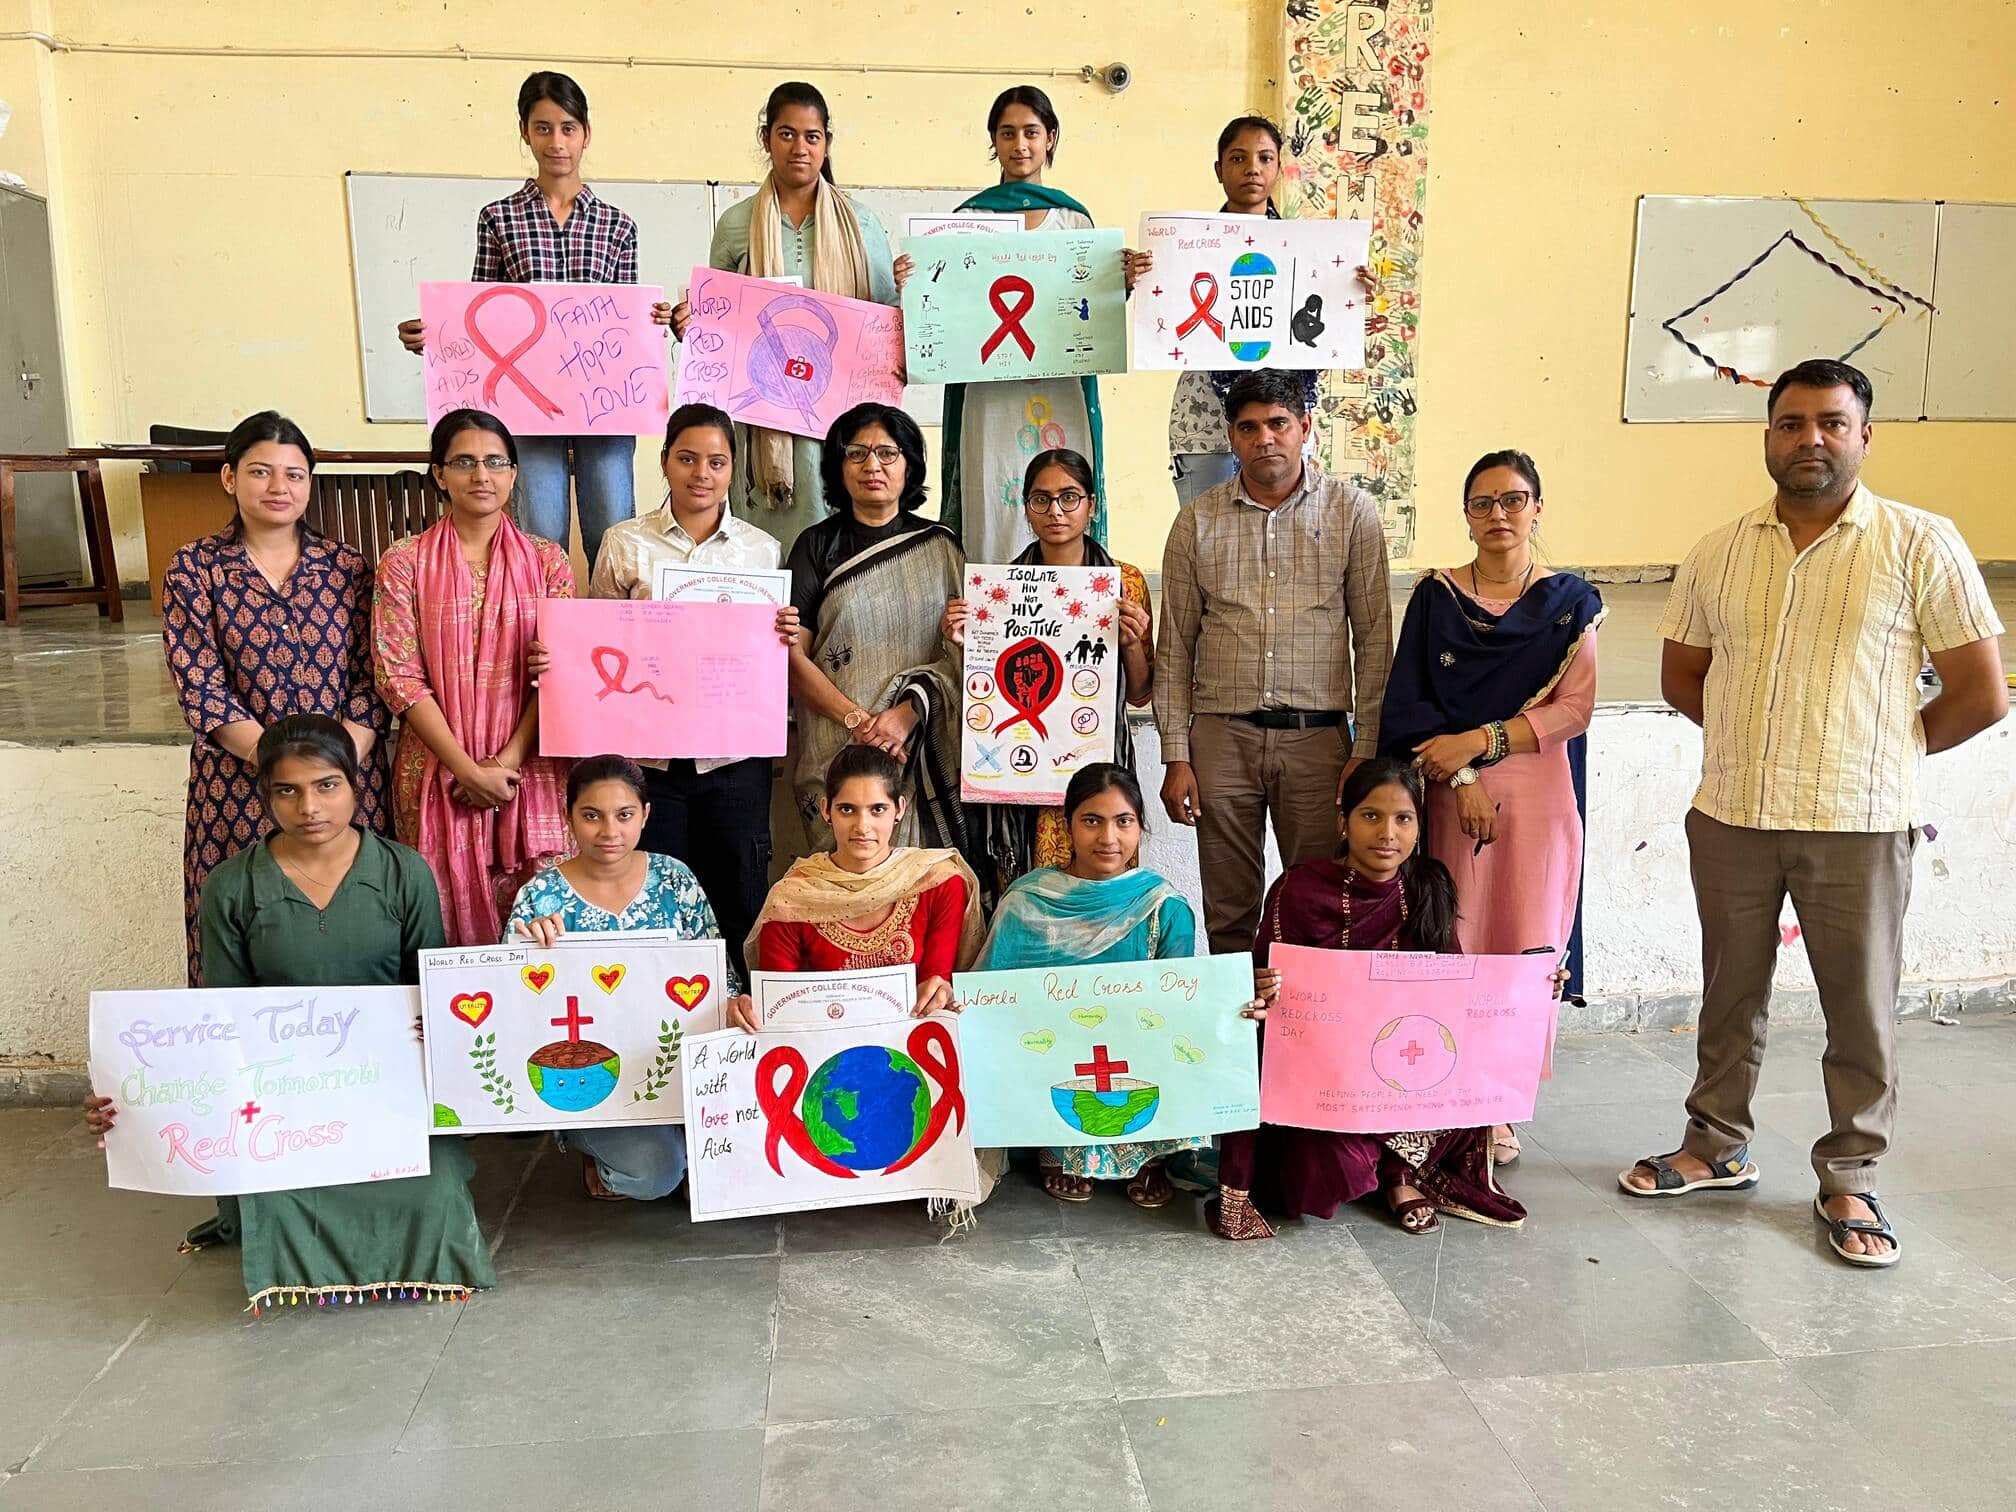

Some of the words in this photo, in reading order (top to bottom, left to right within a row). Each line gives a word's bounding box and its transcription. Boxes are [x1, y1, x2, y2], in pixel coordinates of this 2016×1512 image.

[1223, 224, 1241, 236] DAY
[690, 278, 732, 321] WORLD
[1229, 279, 1274, 301] STOP
[550, 295, 629, 339] FAITH
[1229, 306, 1273, 330] AIDS
[428, 320, 476, 368] WORLD
[686, 326, 724, 356] RED
[557, 327, 629, 382] HOPE
[437, 367, 480, 393] AIDS
[684, 360, 729, 383] CROSS
[580, 366, 659, 427] LOVE
[1006, 567, 1058, 582] ISOLATE
[1021, 583, 1038, 593] HIV
[1024, 595, 1038, 603] NOT
[1011, 603, 1043, 617] HIV
[961, 990, 1018, 1007] World
[1043, 972, 1079, 1002] Red
[1092, 974, 1145, 998] Cross
[1160, 971, 1199, 1003] Day
[1289, 991, 1327, 1003] WORLD
[119, 1013, 240, 1069] Service
[252, 998, 361, 1058] Today
[1280, 1025, 1305, 1038] DAY
[693, 1043, 710, 1070] A
[121, 1067, 227, 1116] Change
[238, 1054, 382, 1099] Tomorrow
[695, 1073, 728, 1098] with
[701, 1107, 729, 1129] love
[735, 1107, 760, 1125] not
[1316, 1102, 1345, 1112] MOST
[159, 1105, 242, 1175] Red
[248, 1113, 348, 1162] Cross
[701, 1138, 733, 1161] Aids
